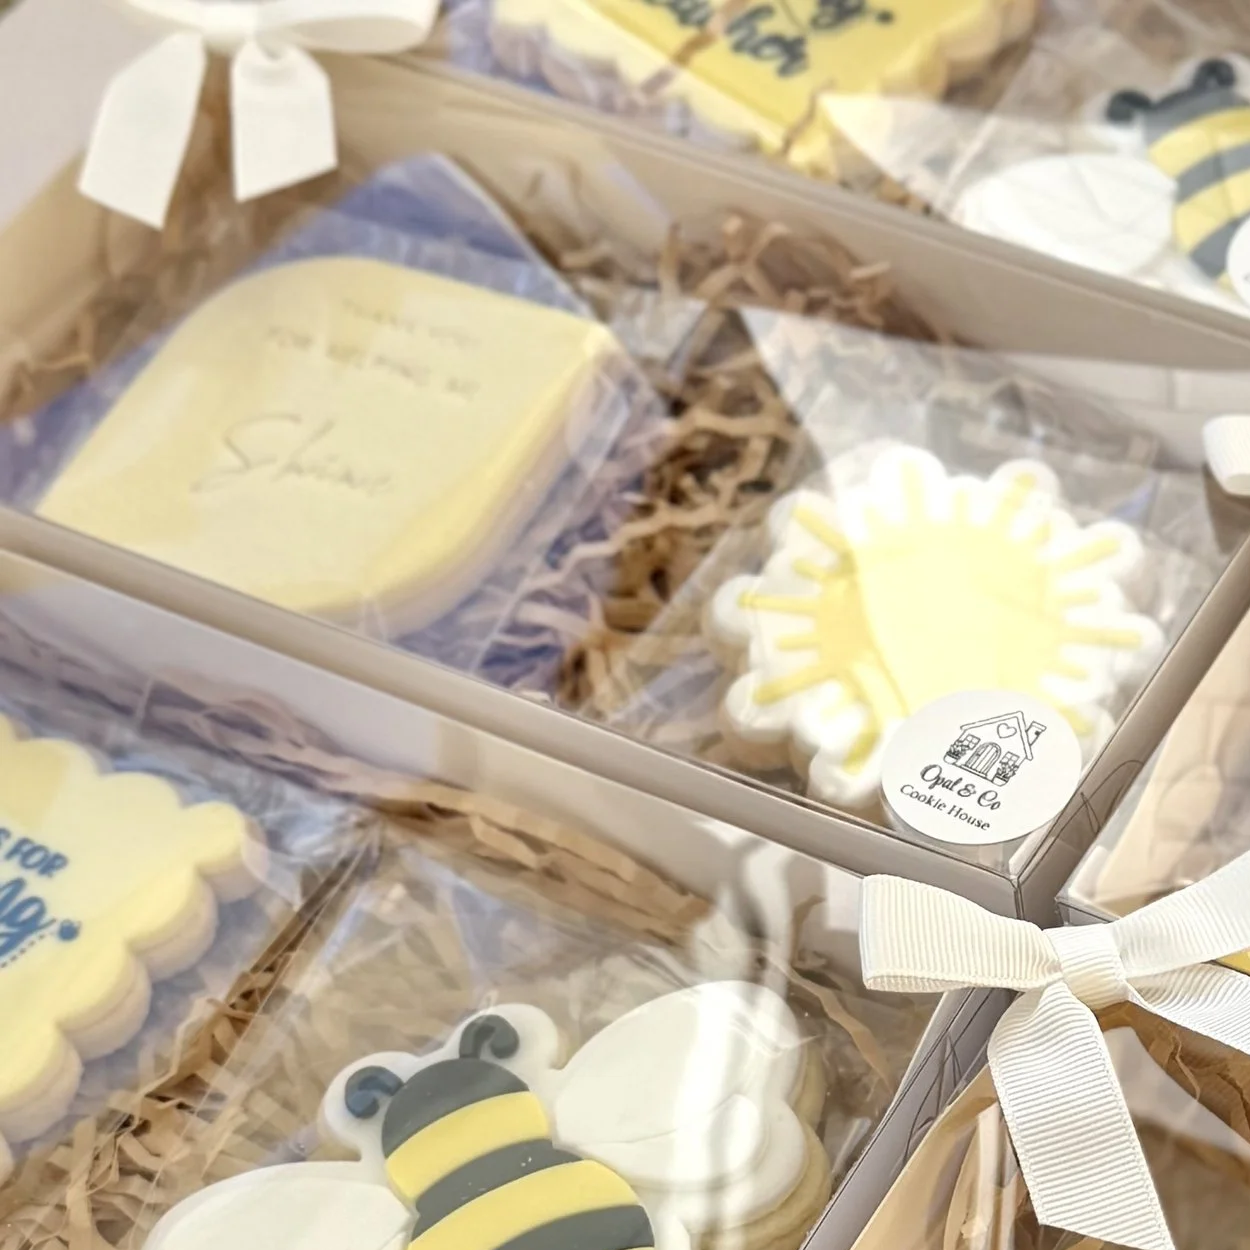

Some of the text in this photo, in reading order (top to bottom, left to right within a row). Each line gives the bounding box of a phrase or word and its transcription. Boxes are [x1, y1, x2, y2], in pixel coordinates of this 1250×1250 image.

[189, 412, 394, 496] Shine
[900, 784, 990, 831] Cookie House
[920, 764, 1001, 811] Opal & Co
[5, 837, 70, 877] FOR
